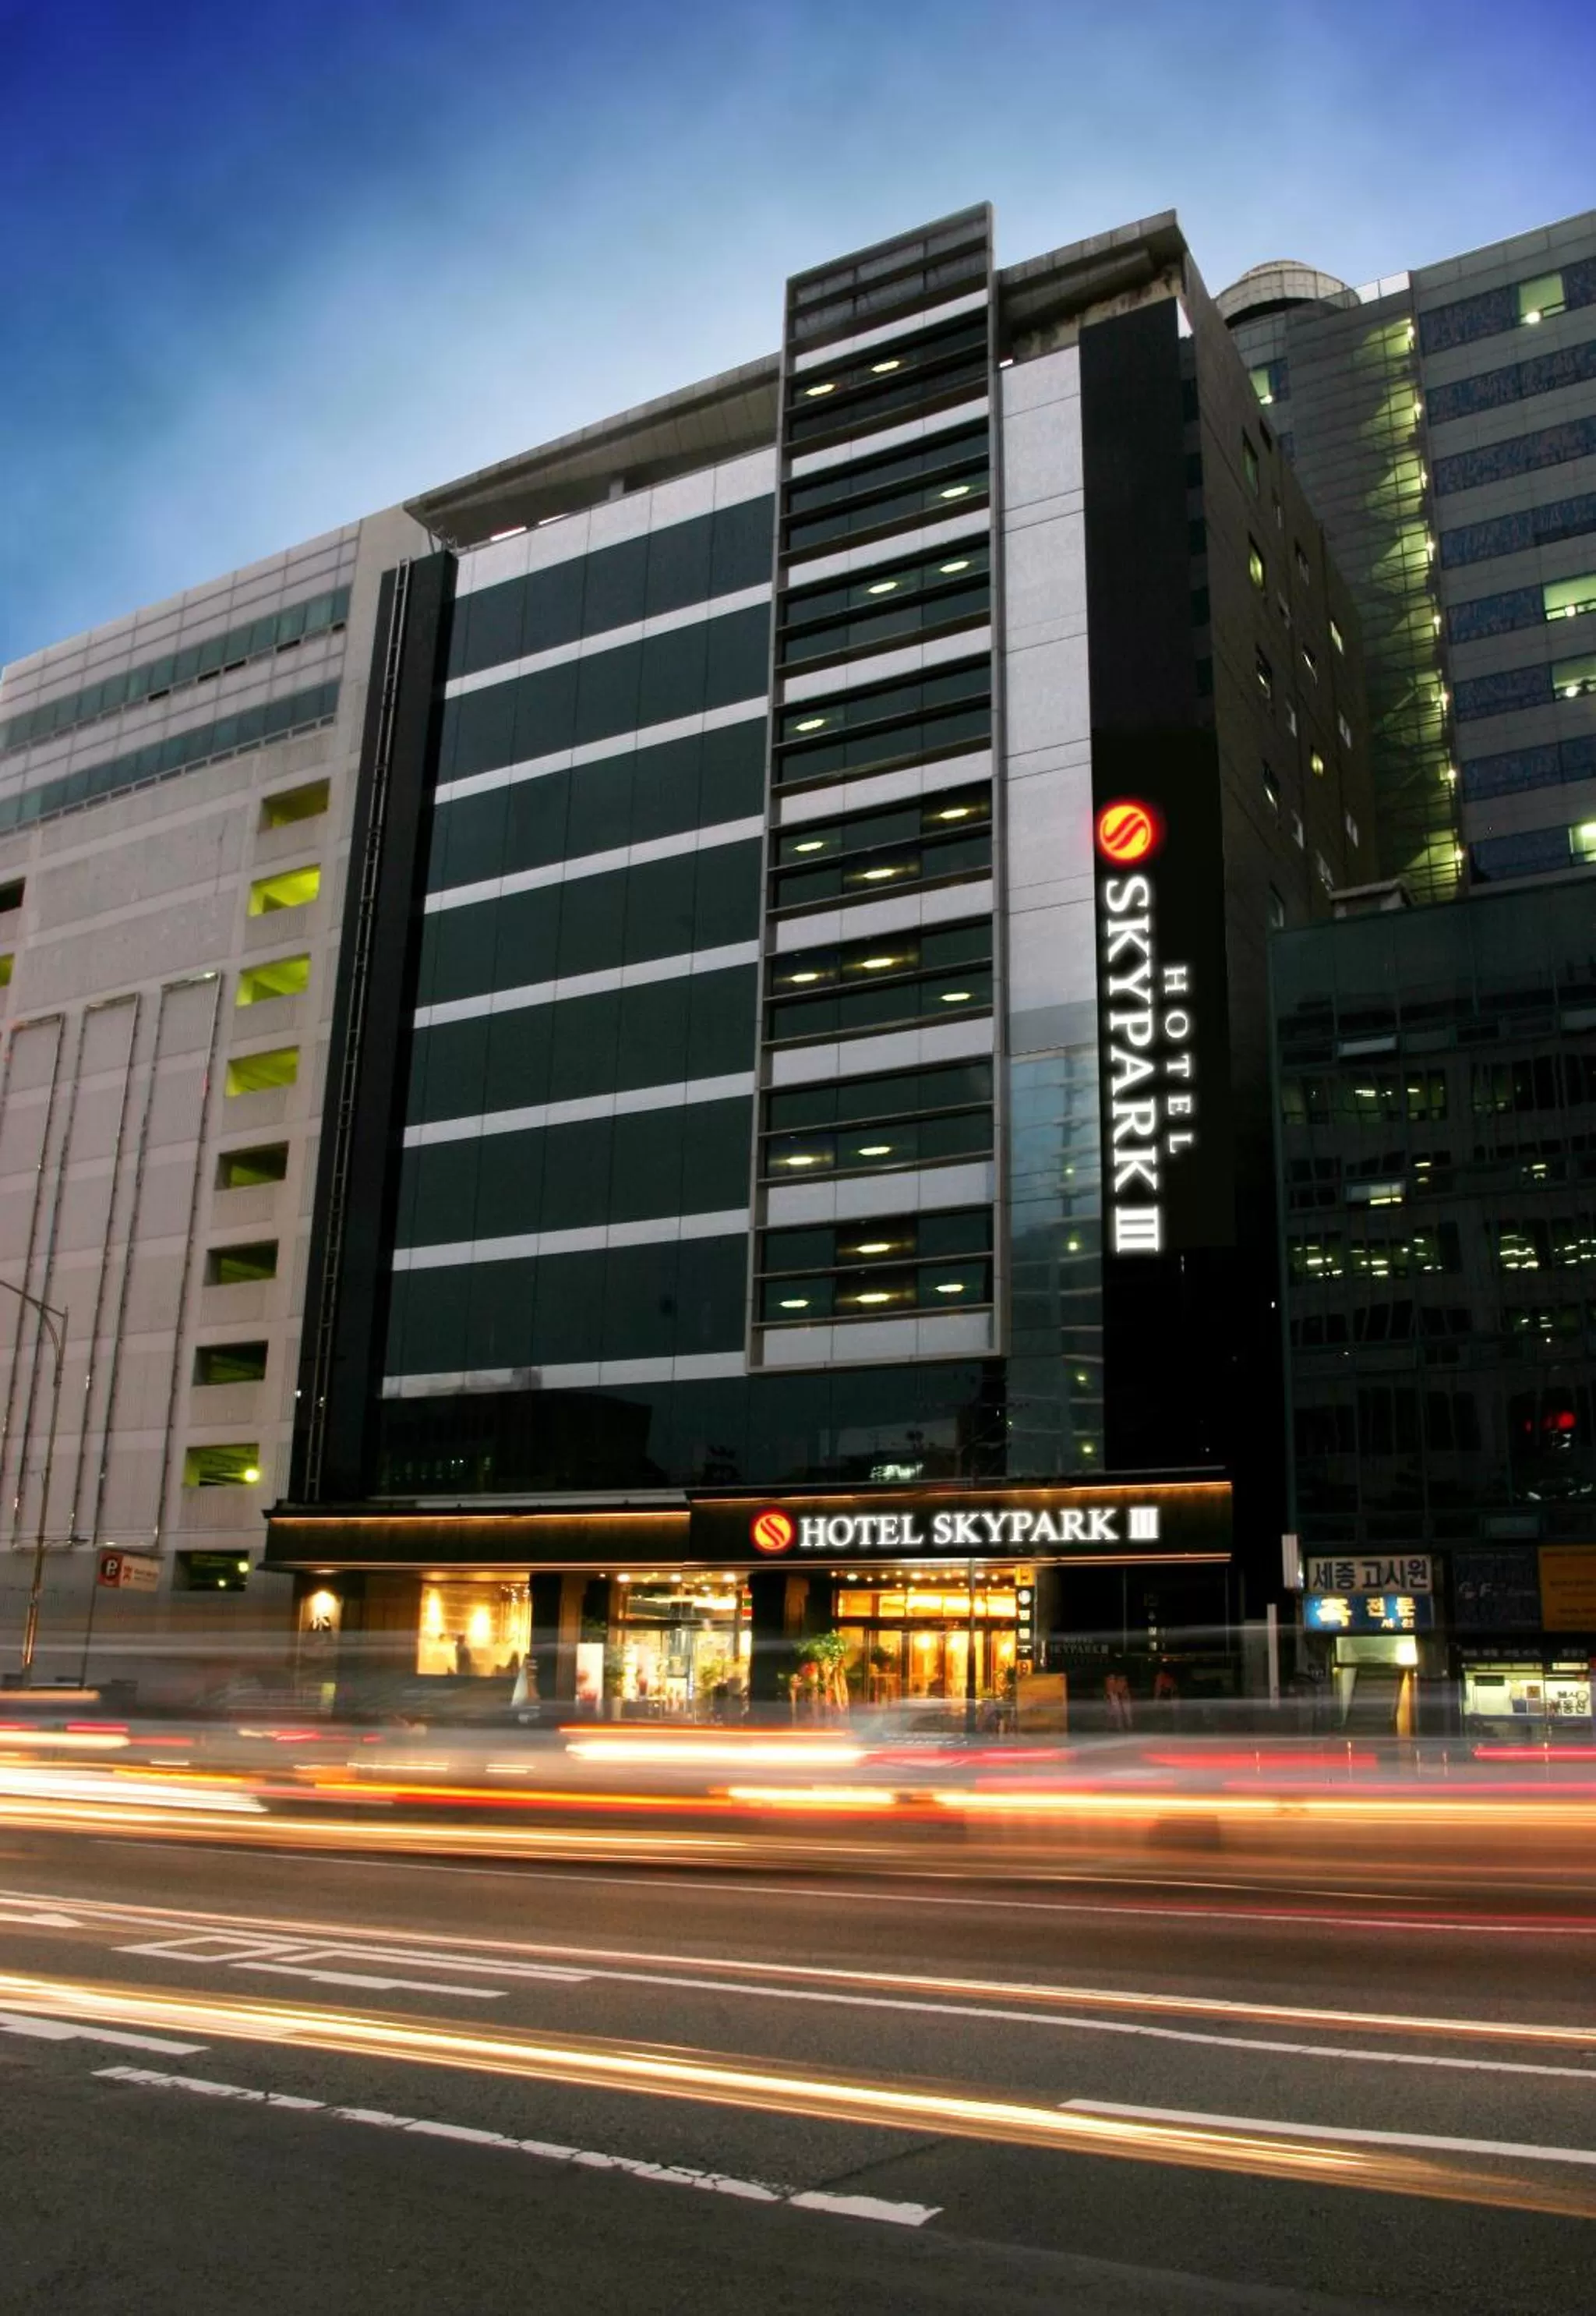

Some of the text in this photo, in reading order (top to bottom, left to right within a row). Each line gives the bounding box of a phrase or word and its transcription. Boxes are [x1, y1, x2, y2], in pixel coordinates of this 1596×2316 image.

[1105, 875, 1158, 1193] SKYPARK
[1163, 966, 1193, 1154] HOTEL
[800, 1514, 924, 1547] HOTEL
[933, 1508, 1119, 1545] SKYPARK
[1313, 1559, 1428, 1589] 세종 고시원
